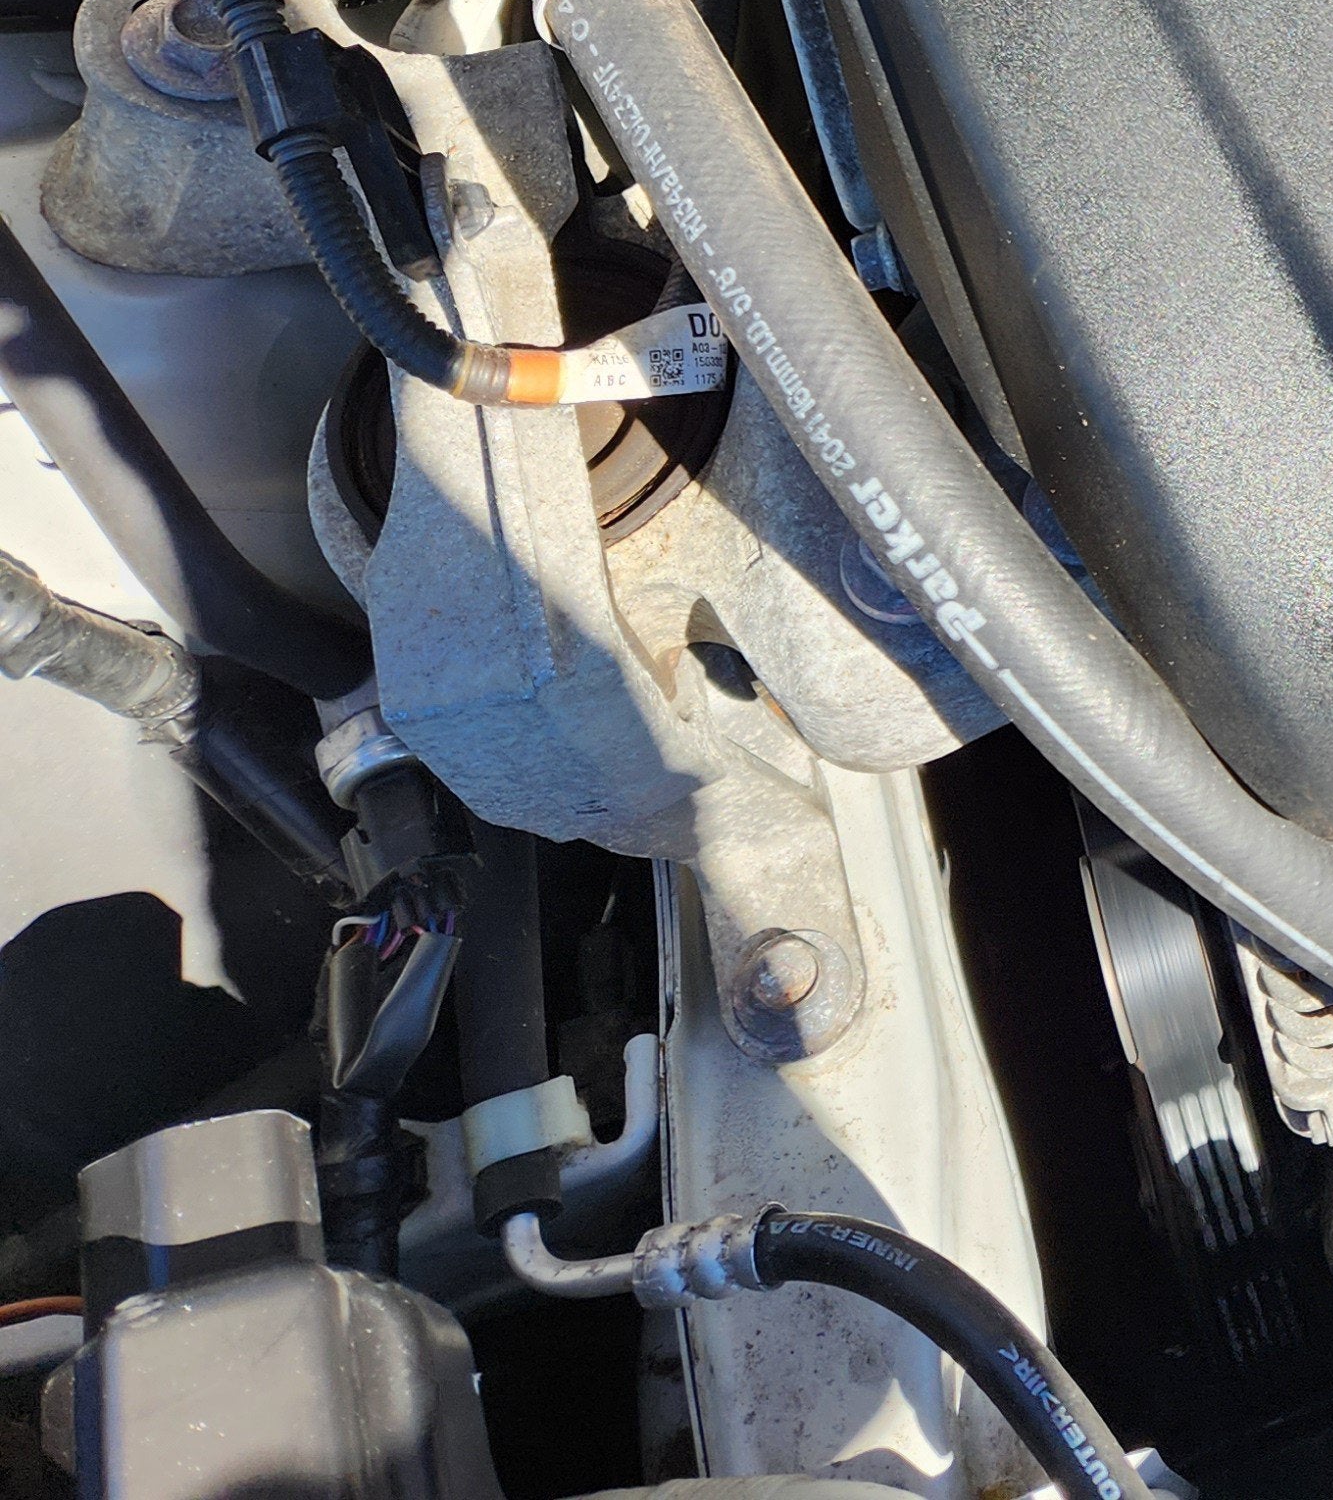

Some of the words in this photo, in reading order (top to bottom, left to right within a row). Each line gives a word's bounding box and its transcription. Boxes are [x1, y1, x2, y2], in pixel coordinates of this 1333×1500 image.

[687, 312, 727, 338] D0
[846, 470, 989, 645] Parker
[757, 1218, 918, 1273] INNER>PA
